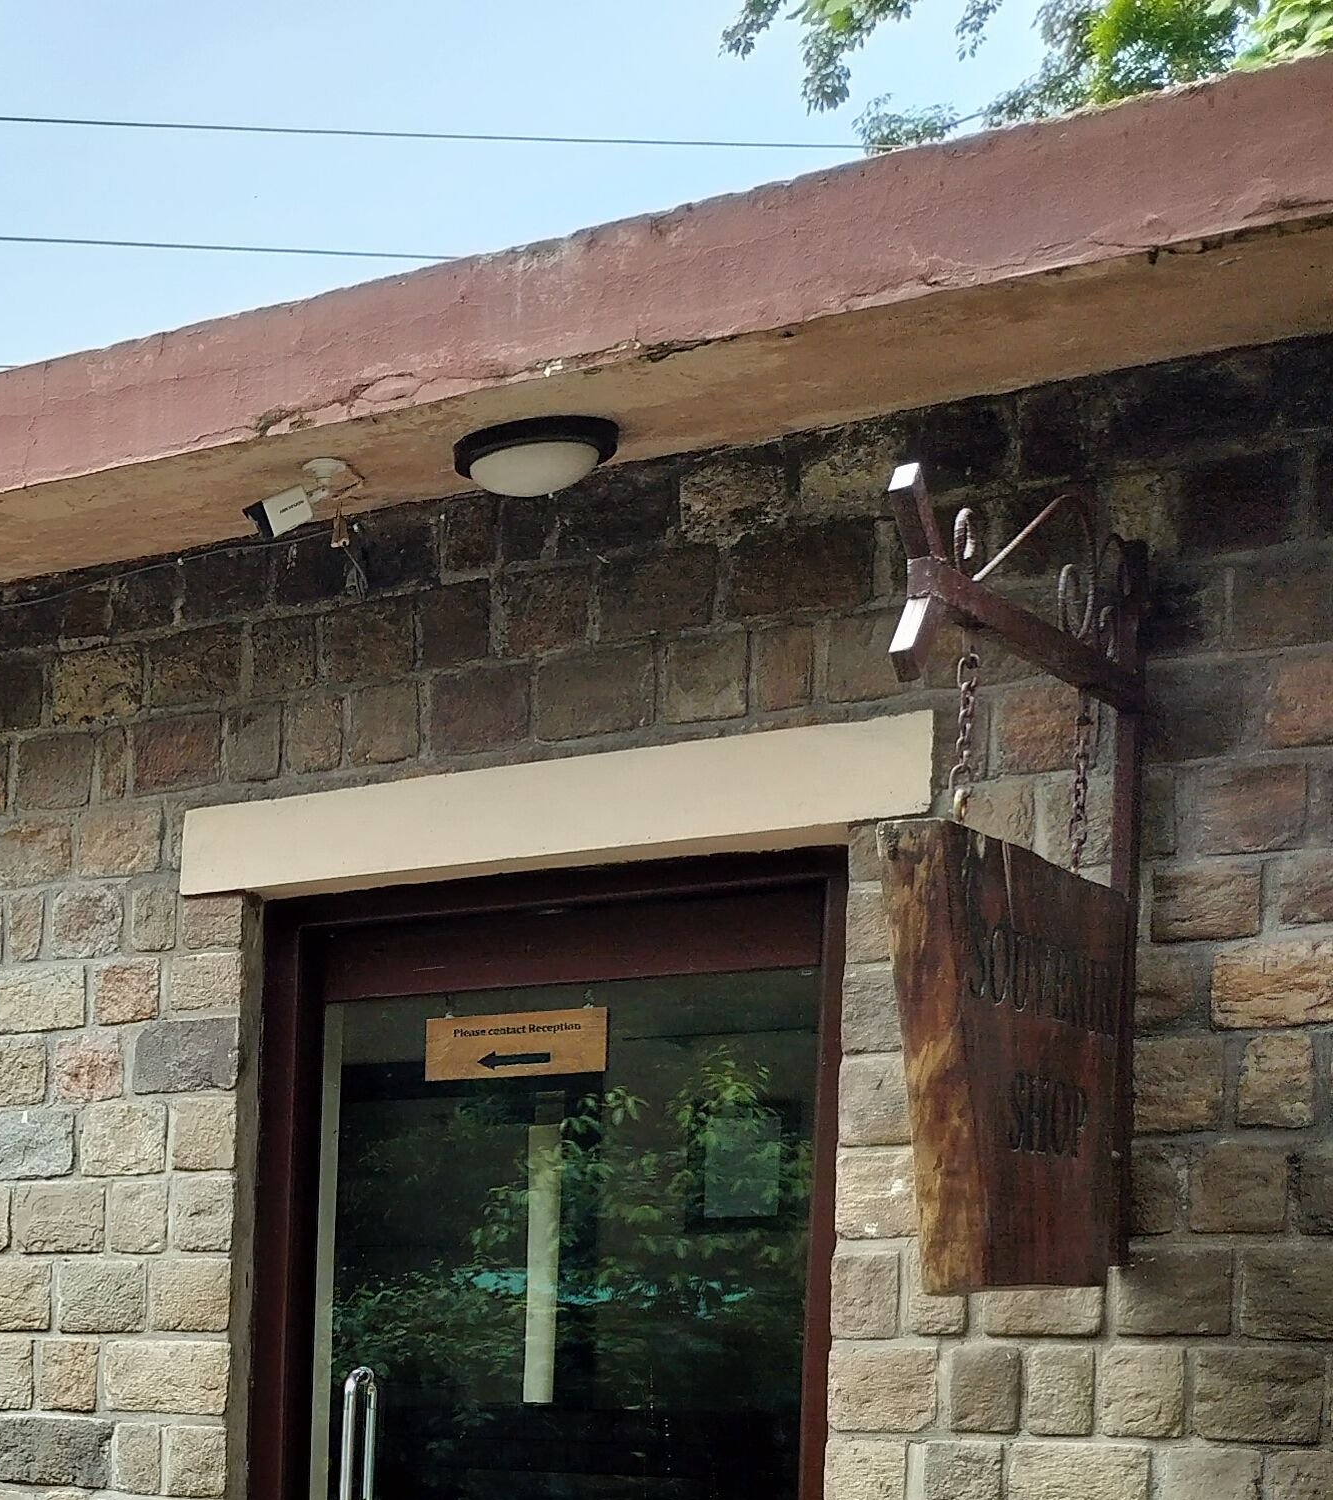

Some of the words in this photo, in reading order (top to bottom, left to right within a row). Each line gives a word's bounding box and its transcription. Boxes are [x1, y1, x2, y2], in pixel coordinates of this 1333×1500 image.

[454, 1028, 486, 1038] Please
[488, 1024, 527, 1036] contact
[528, 1022, 582, 1034] Reception
[1007, 1071, 1089, 1157] SHOP
